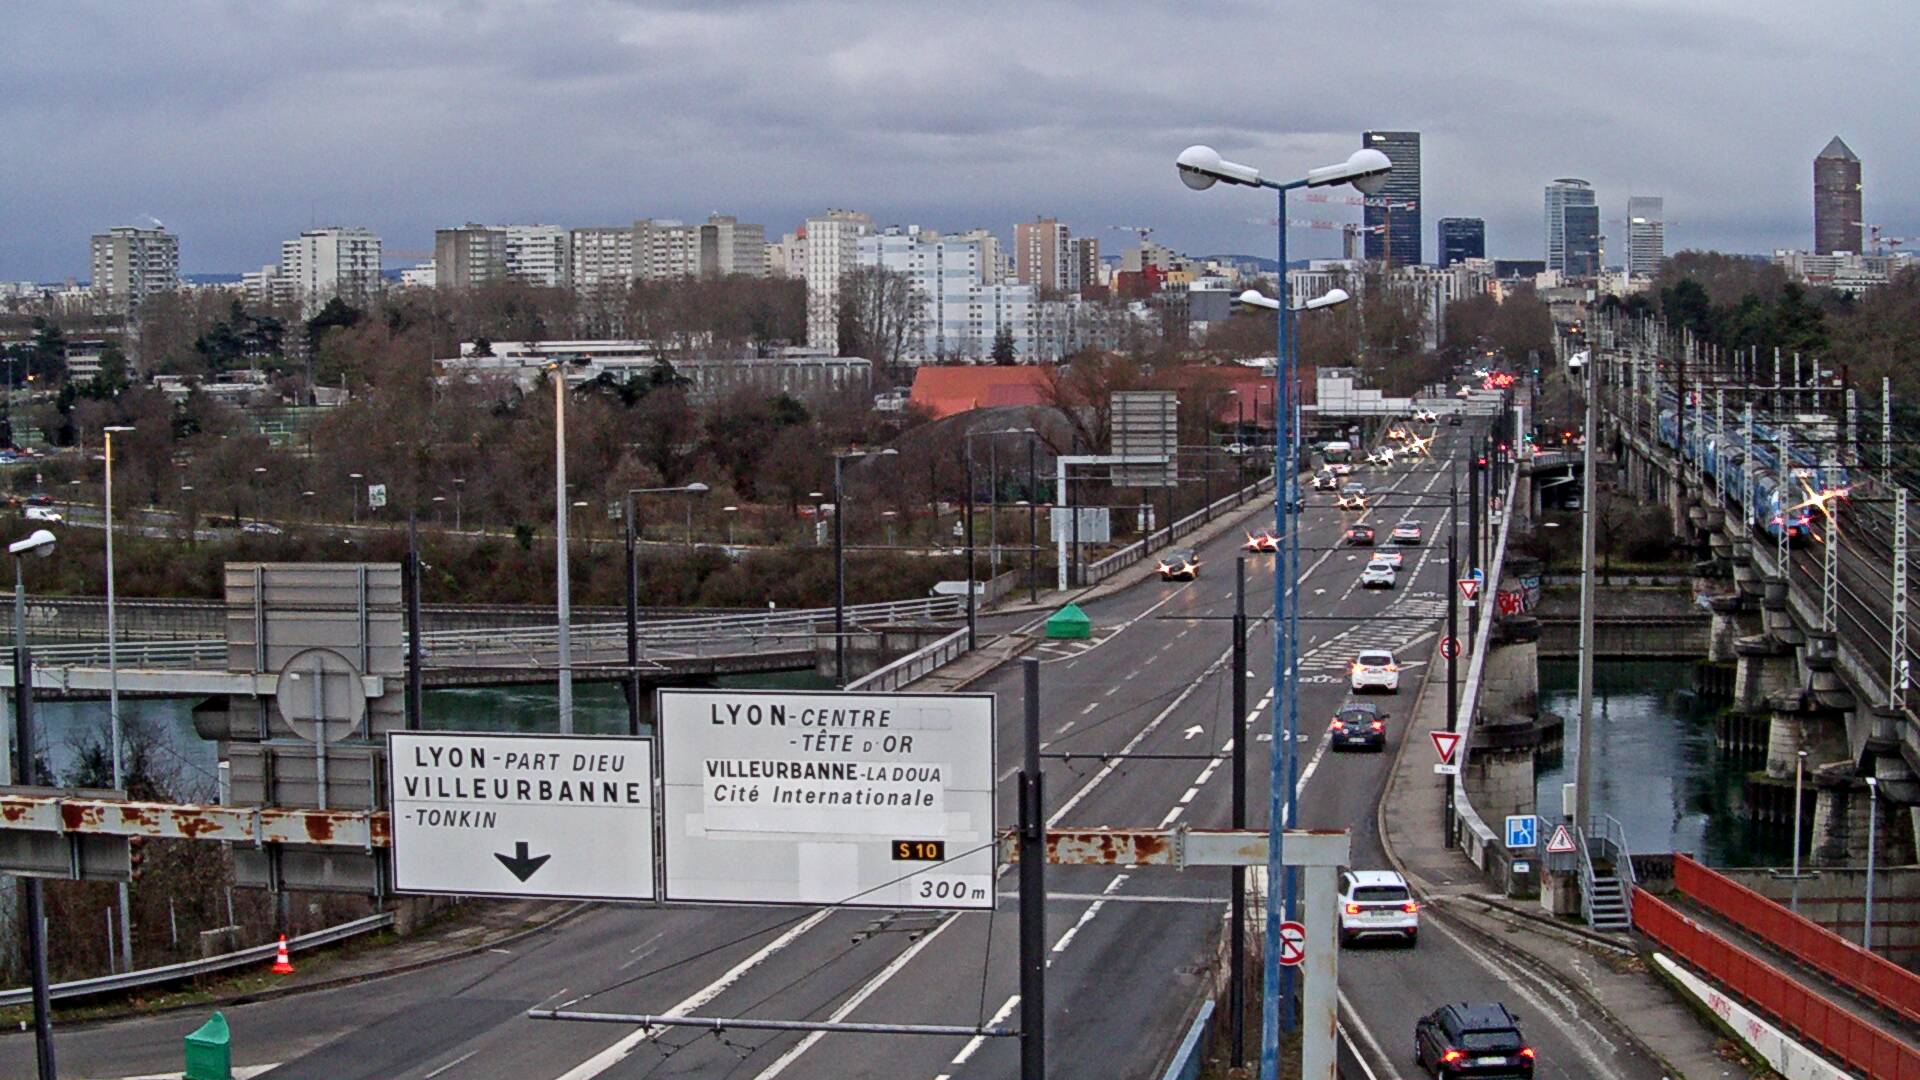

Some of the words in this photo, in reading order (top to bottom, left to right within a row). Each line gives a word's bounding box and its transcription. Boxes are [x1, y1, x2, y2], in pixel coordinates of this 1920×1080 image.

[711, 703, 891, 728] LYON-CENTRE
[572, 754, 625, 772] DIEU
[892, 767, 941, 783] DOUA
[404, 776, 641, 804] VILLEURBANNE
[714, 784, 759, 803] Cité
[772, 785, 934, 807] Internationale
[899, 843, 910, 858] S
[916, 843, 937, 858] 10
[920, 880, 967, 899] 300
[971, 889, 985, 899] m
